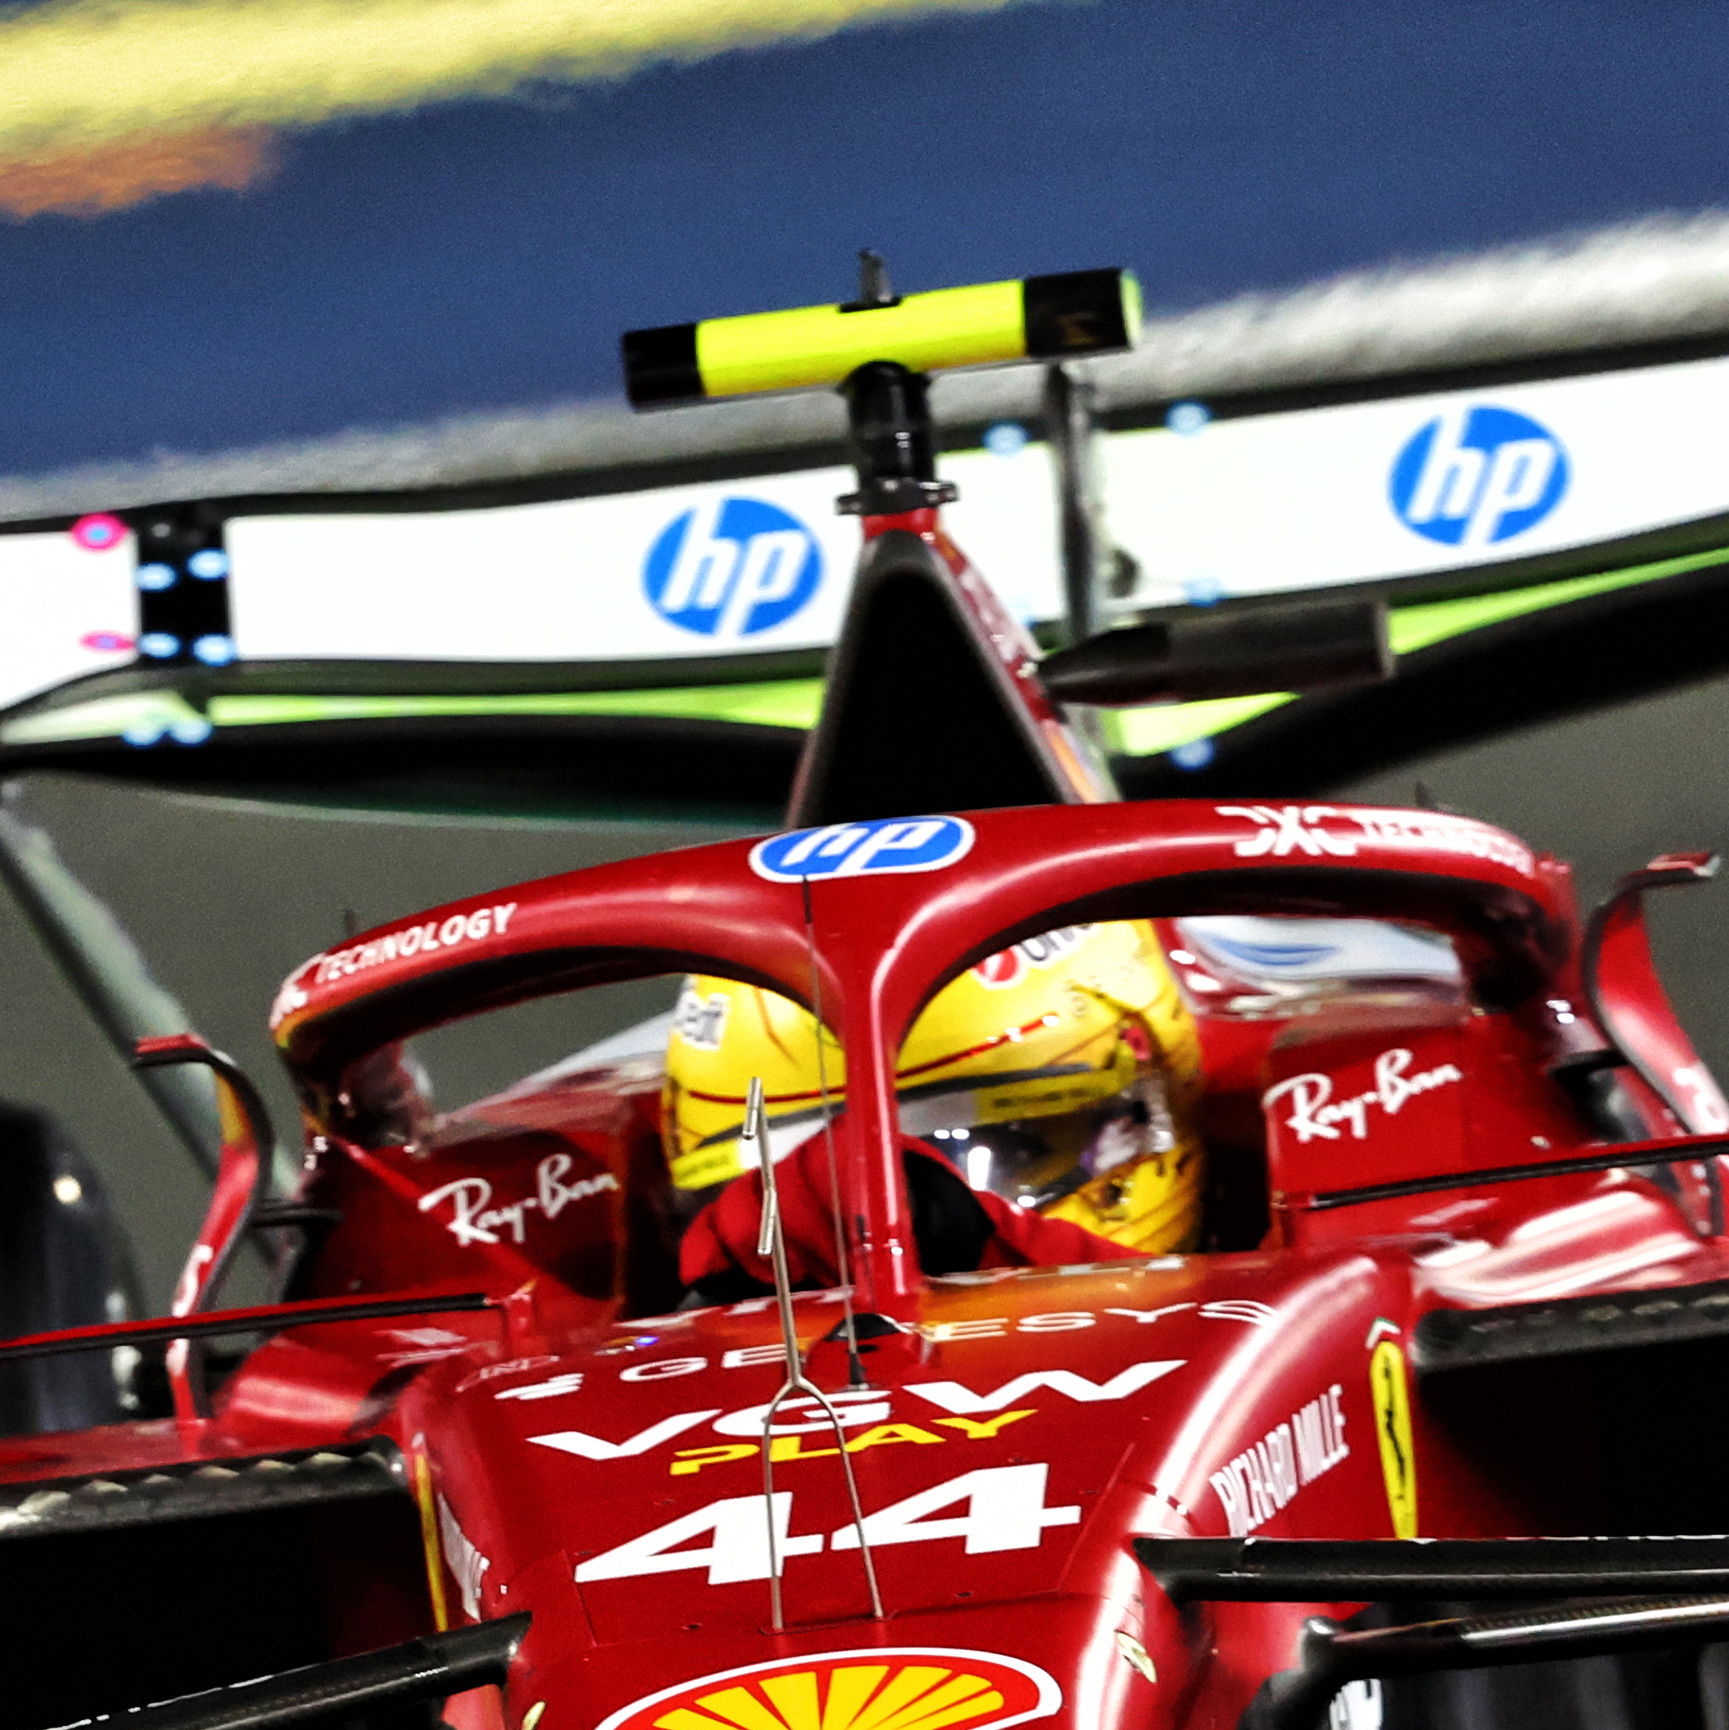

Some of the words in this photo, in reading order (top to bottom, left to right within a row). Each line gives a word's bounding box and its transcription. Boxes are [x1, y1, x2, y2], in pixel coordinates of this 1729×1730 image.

[1406, 406, 1557, 547] hp
[660, 496, 806, 639] hp
[1264, 1048, 1462, 1142] Ray-Ban
[418, 1154, 618, 1246] Ray-Ban
[524, 1359, 1188, 1461] VGW
[669, 1409, 1038, 1475] PLAY
[575, 1463, 1080, 1585] 44
